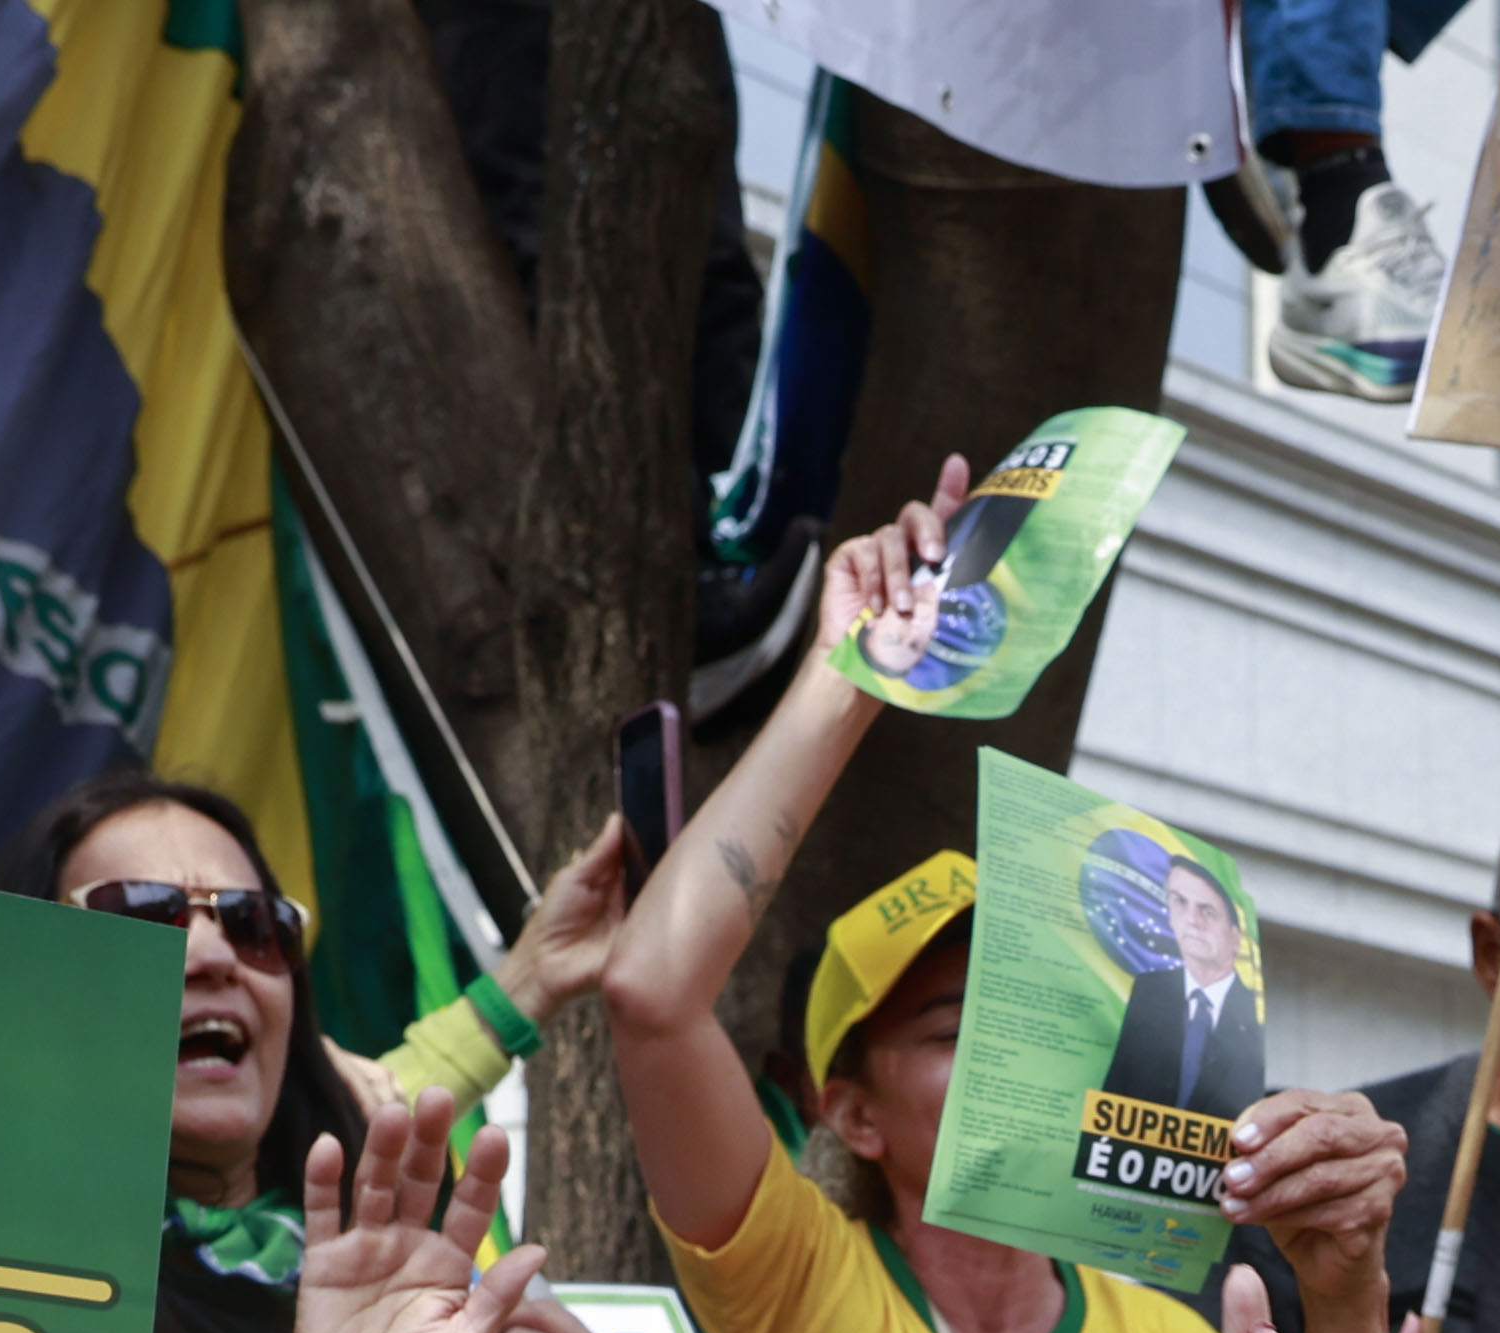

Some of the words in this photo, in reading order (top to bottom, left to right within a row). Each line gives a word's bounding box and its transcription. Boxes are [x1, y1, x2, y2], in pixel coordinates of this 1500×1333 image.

[878, 867, 976, 922] BRA
[1093, 1099, 1237, 1159] SUPREM
[1086, 1136, 1113, 1179] É
[1118, 1150, 1144, 1185] O
